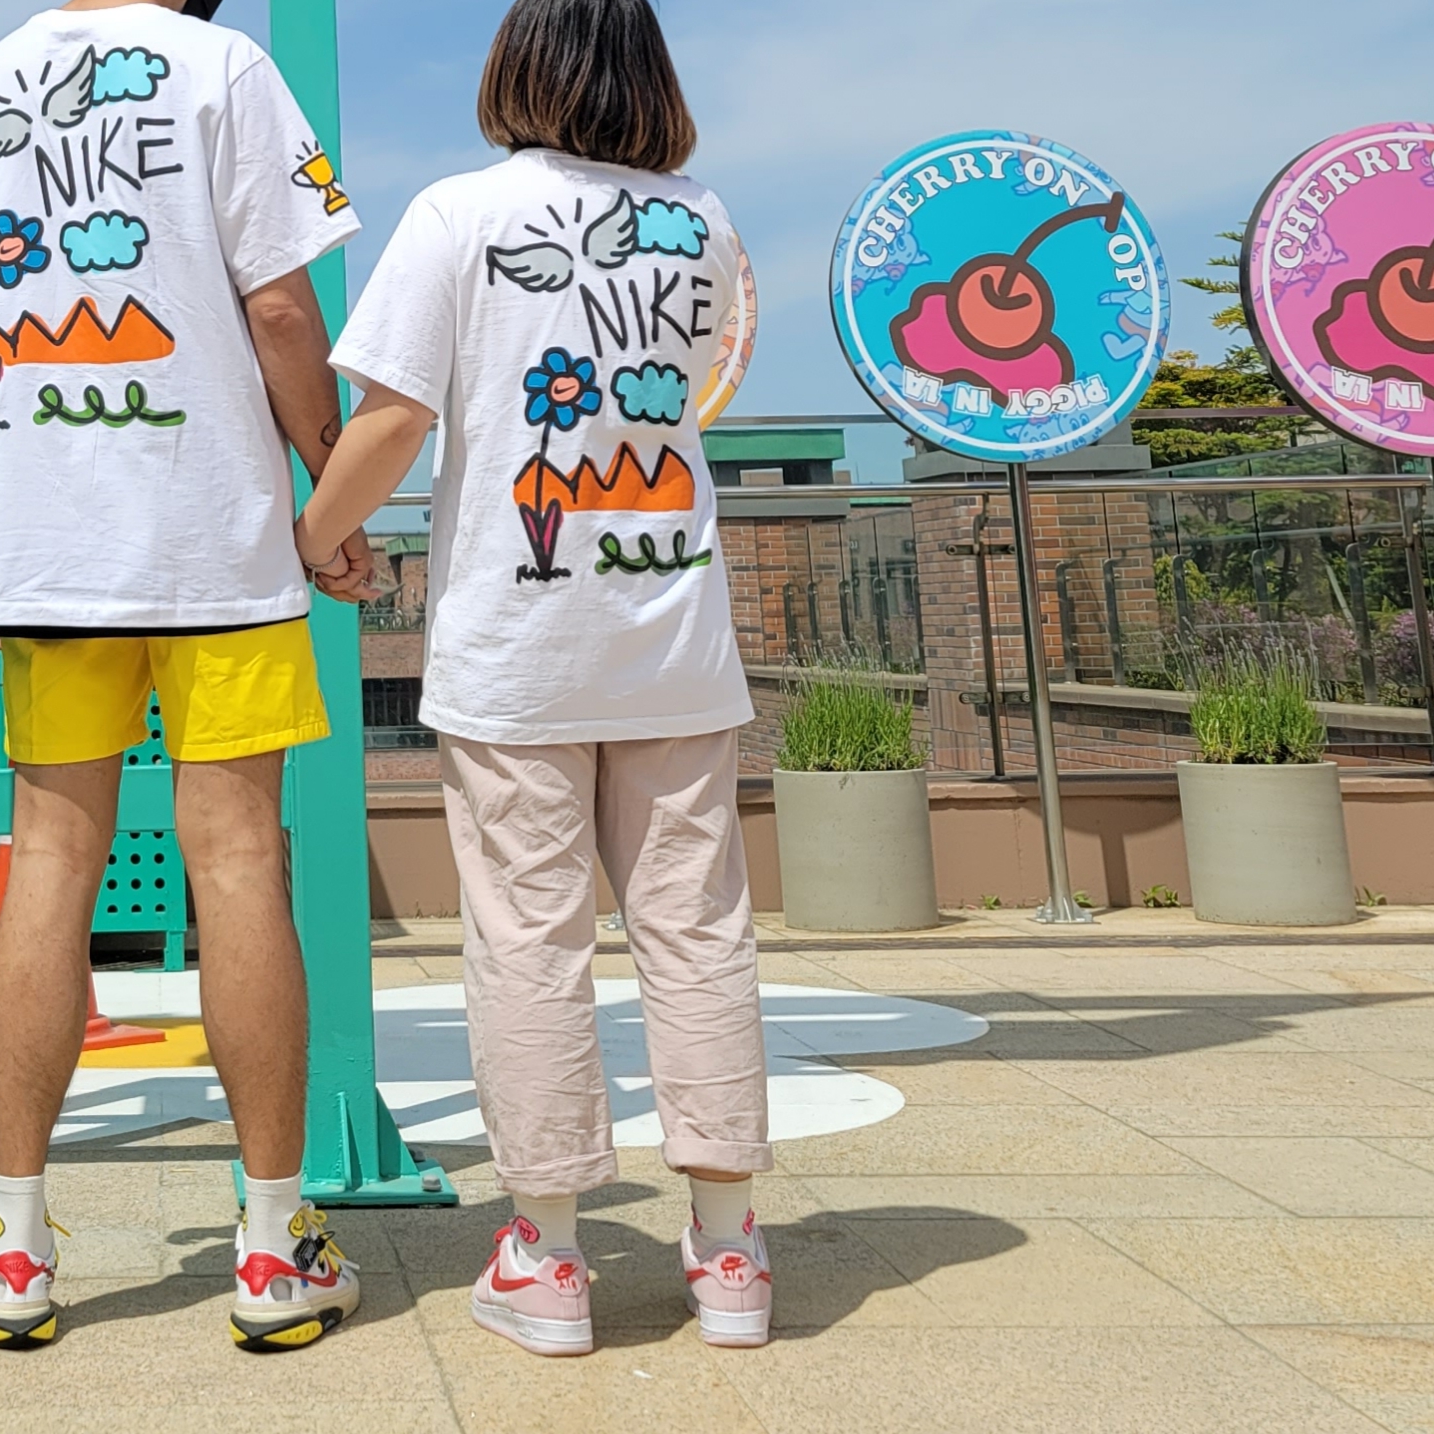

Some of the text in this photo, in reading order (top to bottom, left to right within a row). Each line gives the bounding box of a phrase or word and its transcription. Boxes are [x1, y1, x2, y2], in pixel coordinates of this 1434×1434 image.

[34, 116, 184, 217] NIKE
[857, 150, 1013, 268] CHERRY
[1023, 157, 1090, 207] ON
[1273, 141, 1418, 270] CHERRY
[579, 267, 713, 358] NIKE
[903, 367, 1109, 417] PIGGY IN LA
[1332, 367, 1425, 411] IN LA
